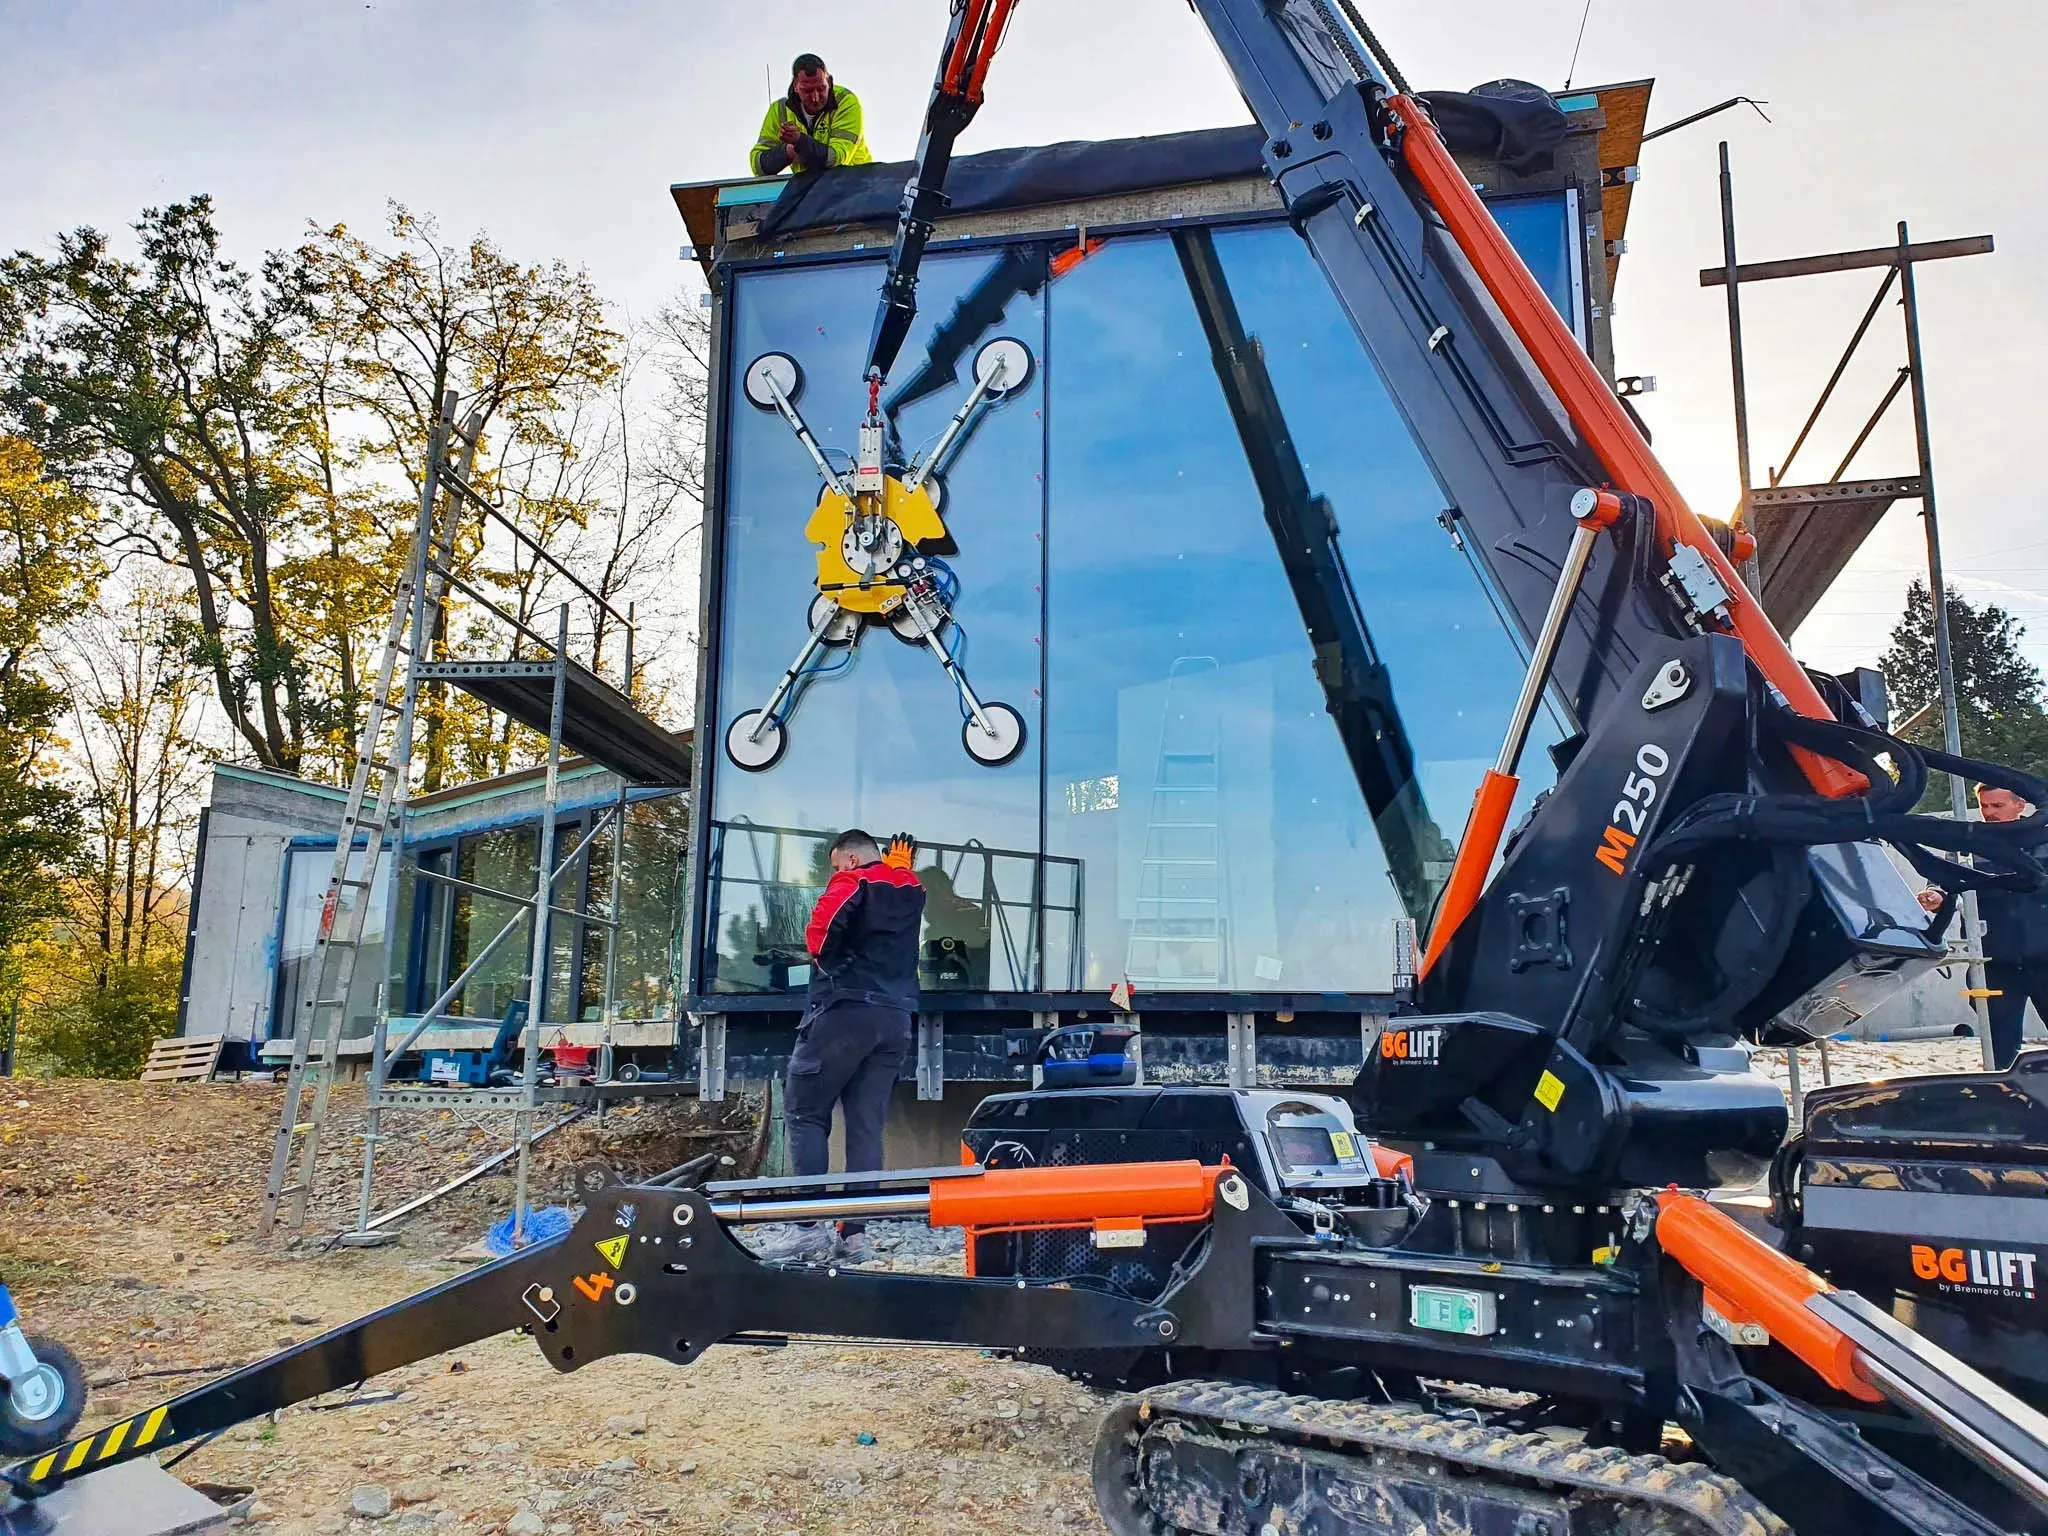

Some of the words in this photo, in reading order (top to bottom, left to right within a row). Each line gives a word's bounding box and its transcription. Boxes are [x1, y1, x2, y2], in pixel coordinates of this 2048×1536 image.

[1595, 743, 1670, 875] M250
[573, 1271, 614, 1302] 4
[1939, 1283, 1951, 1293] by
[1954, 1284, 1999, 1296] Brennero
[2003, 1288, 2021, 1298] Gru
